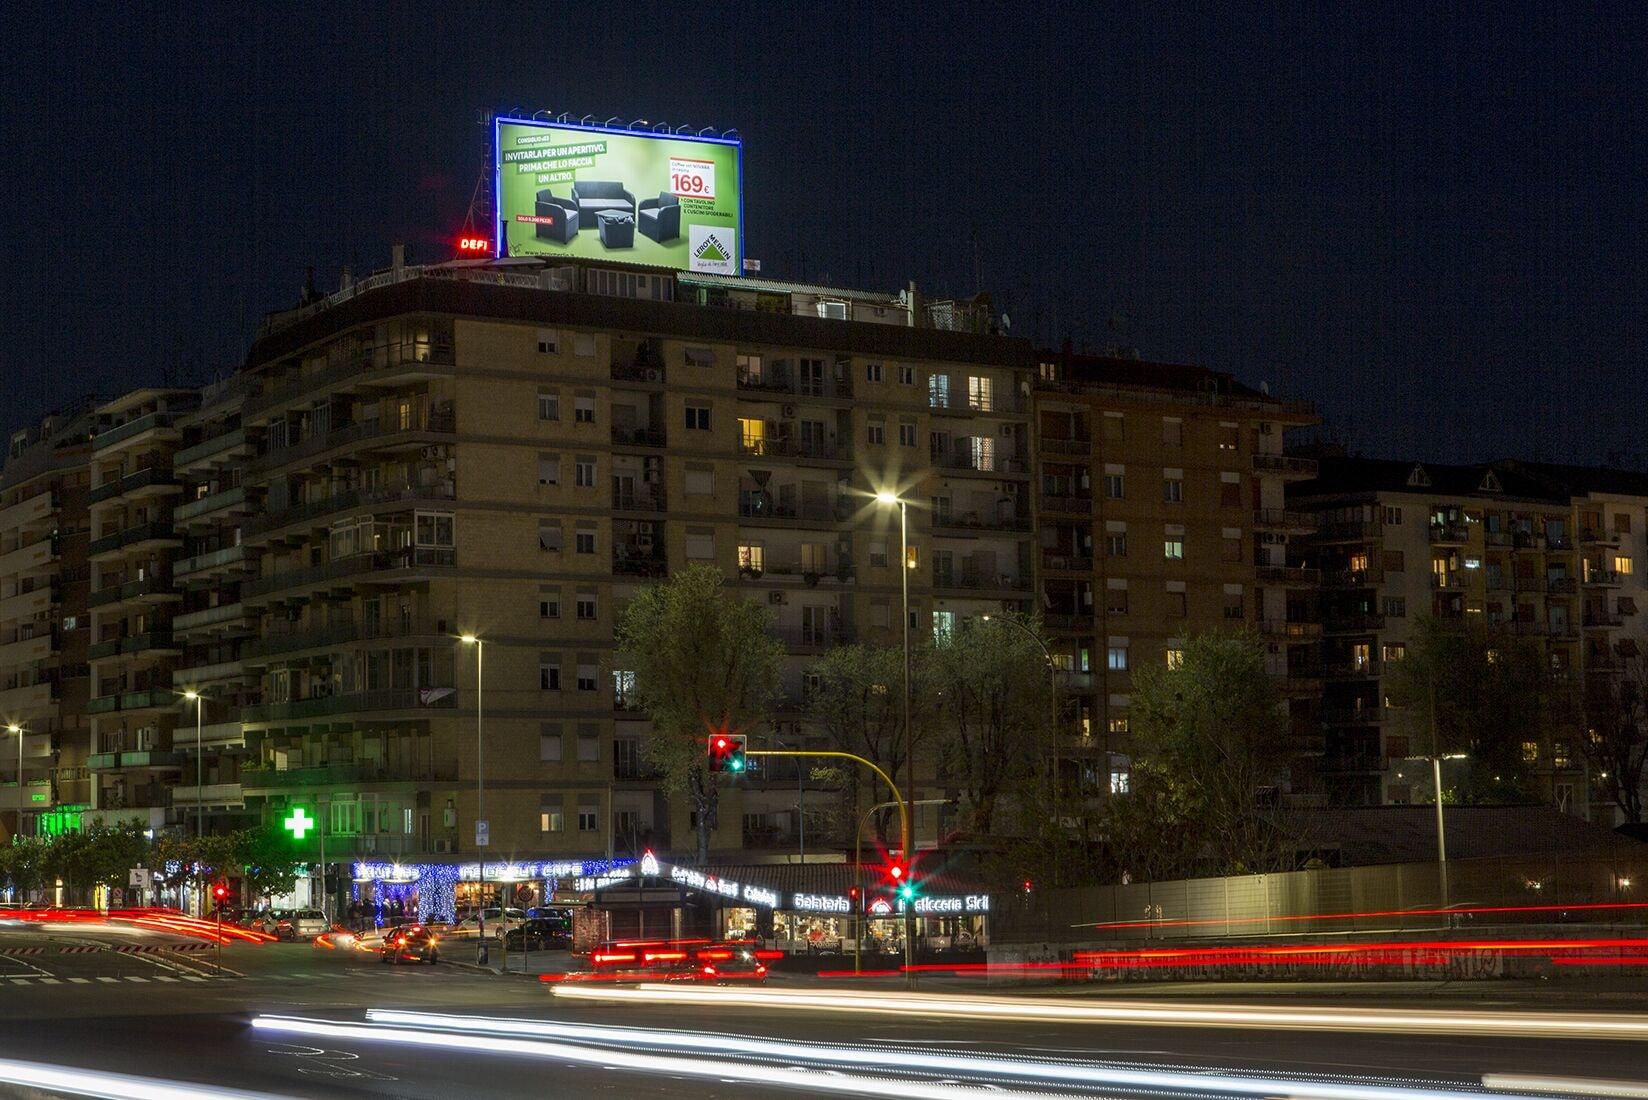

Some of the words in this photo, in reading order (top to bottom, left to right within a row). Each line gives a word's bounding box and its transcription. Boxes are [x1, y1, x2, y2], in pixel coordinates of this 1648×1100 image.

[505, 150, 543, 161] INVITARLA
[543, 148, 557, 158] PER
[557, 146, 568, 157] UN
[568, 143, 605, 155] APERITIVO.
[519, 162, 542, 173] PRIMA
[542, 160, 558, 170] CHE
[558, 158, 568, 168] LO
[568, 156, 593, 167] FACCIA
[538, 174, 549, 183] UN
[549, 171, 573, 182] ALTRO.
[671, 174, 703, 193] 169
[460, 238, 488, 250] DEFI
[693, 238, 711, 258] LEROY
[709, 233, 732, 260] MERLIN
[794, 894, 850, 912] Gelateria
